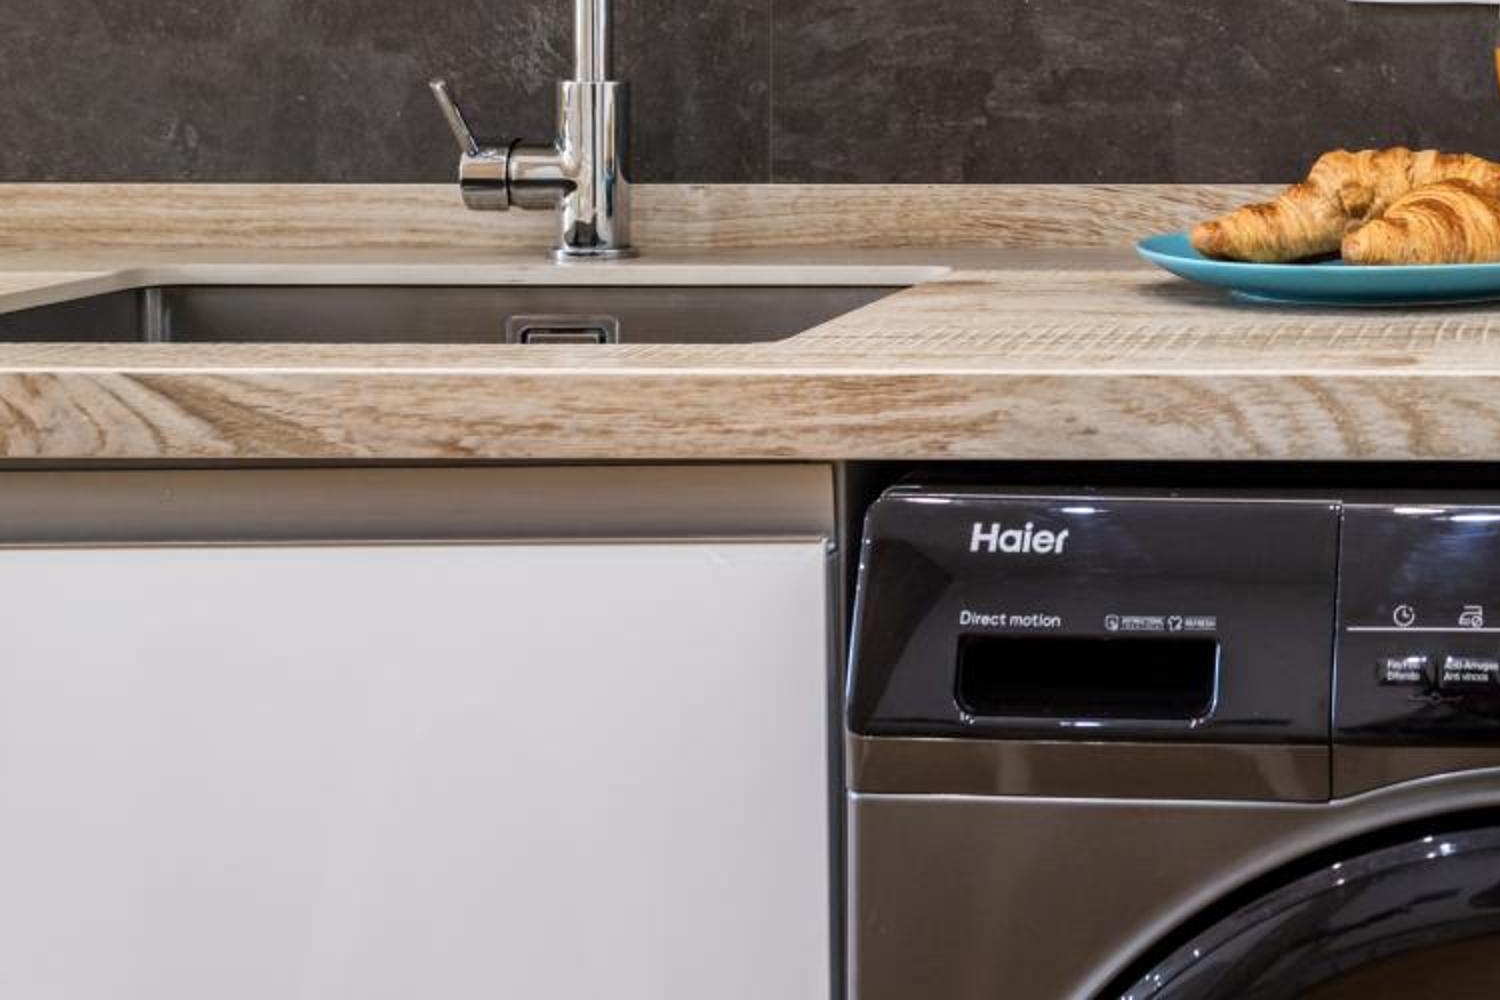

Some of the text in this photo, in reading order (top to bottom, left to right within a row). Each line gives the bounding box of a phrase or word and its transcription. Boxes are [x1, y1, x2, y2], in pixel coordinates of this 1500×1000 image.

[969, 521, 1070, 554] Haier
[959, 609, 1061, 627] Direct motion
